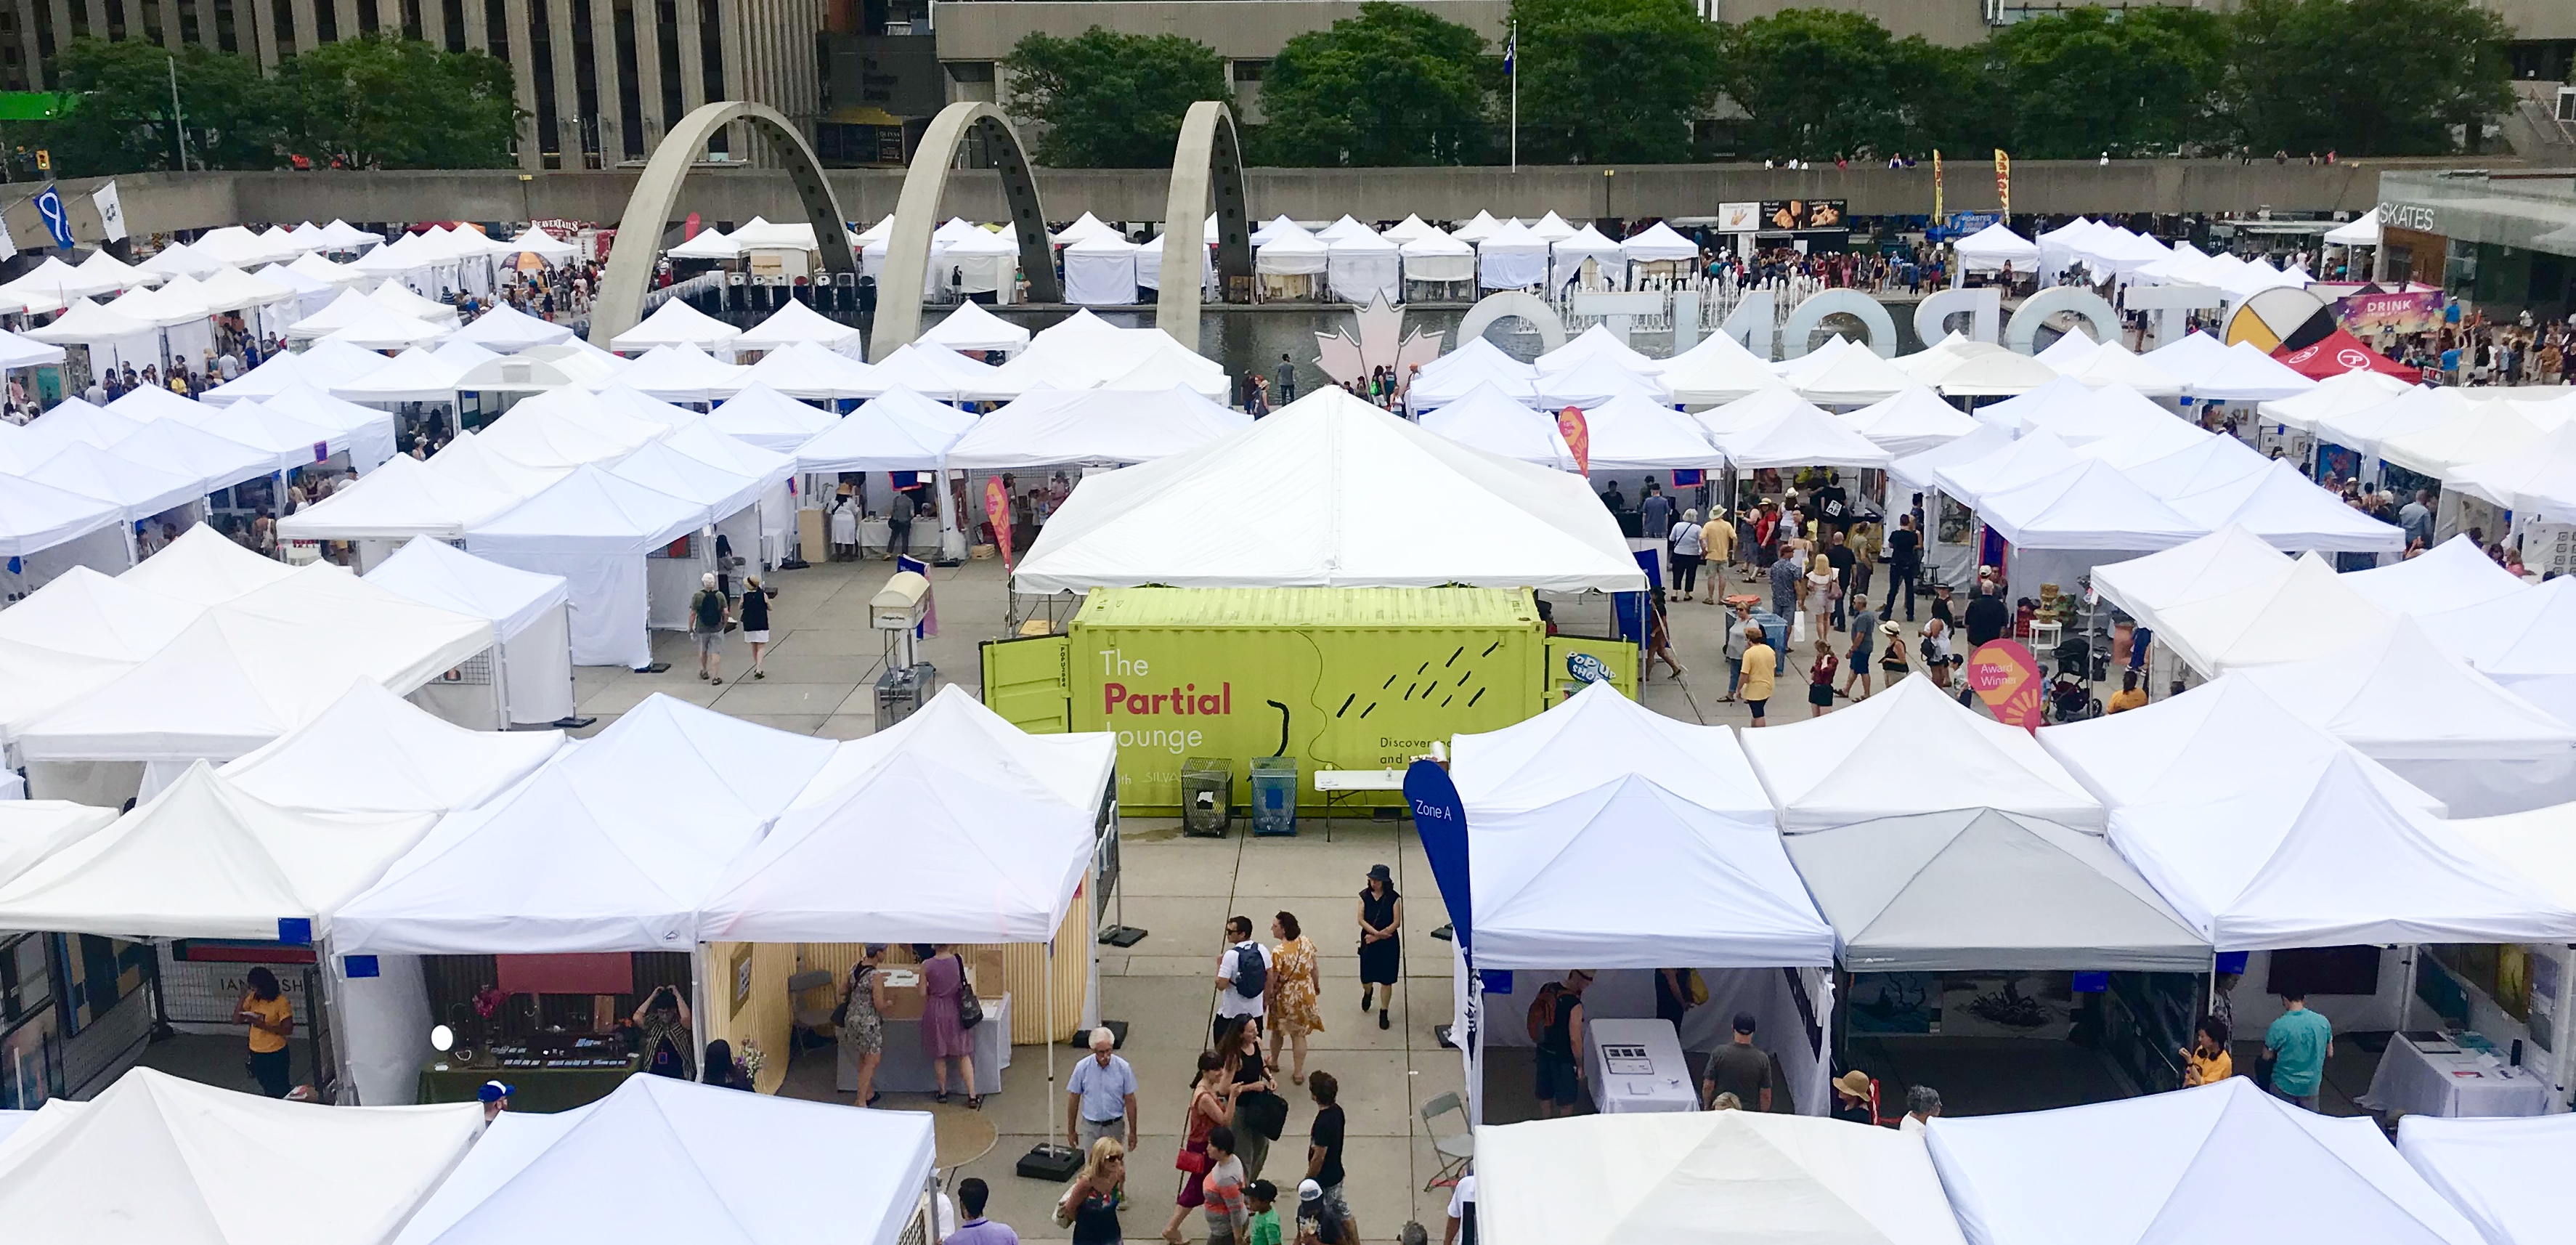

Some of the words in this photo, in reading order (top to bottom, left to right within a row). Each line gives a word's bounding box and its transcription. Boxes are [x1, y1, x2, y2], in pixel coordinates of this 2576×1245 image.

[2379, 202, 2434, 231] SKATES
[2367, 299, 2412, 312] DRINK
[1100, 649, 1148, 676] The
[1980, 662, 2013, 673] Award
[1980, 676, 2018, 686] Winner
[1105, 681, 1230, 715] Partial
[1381, 737, 1430, 748] Discover
[1380, 753, 1402, 764] and
[1118, 774, 1131, 785] ith
[1415, 799, 1442, 819] Zone
[1444, 806, 1452, 822] A
